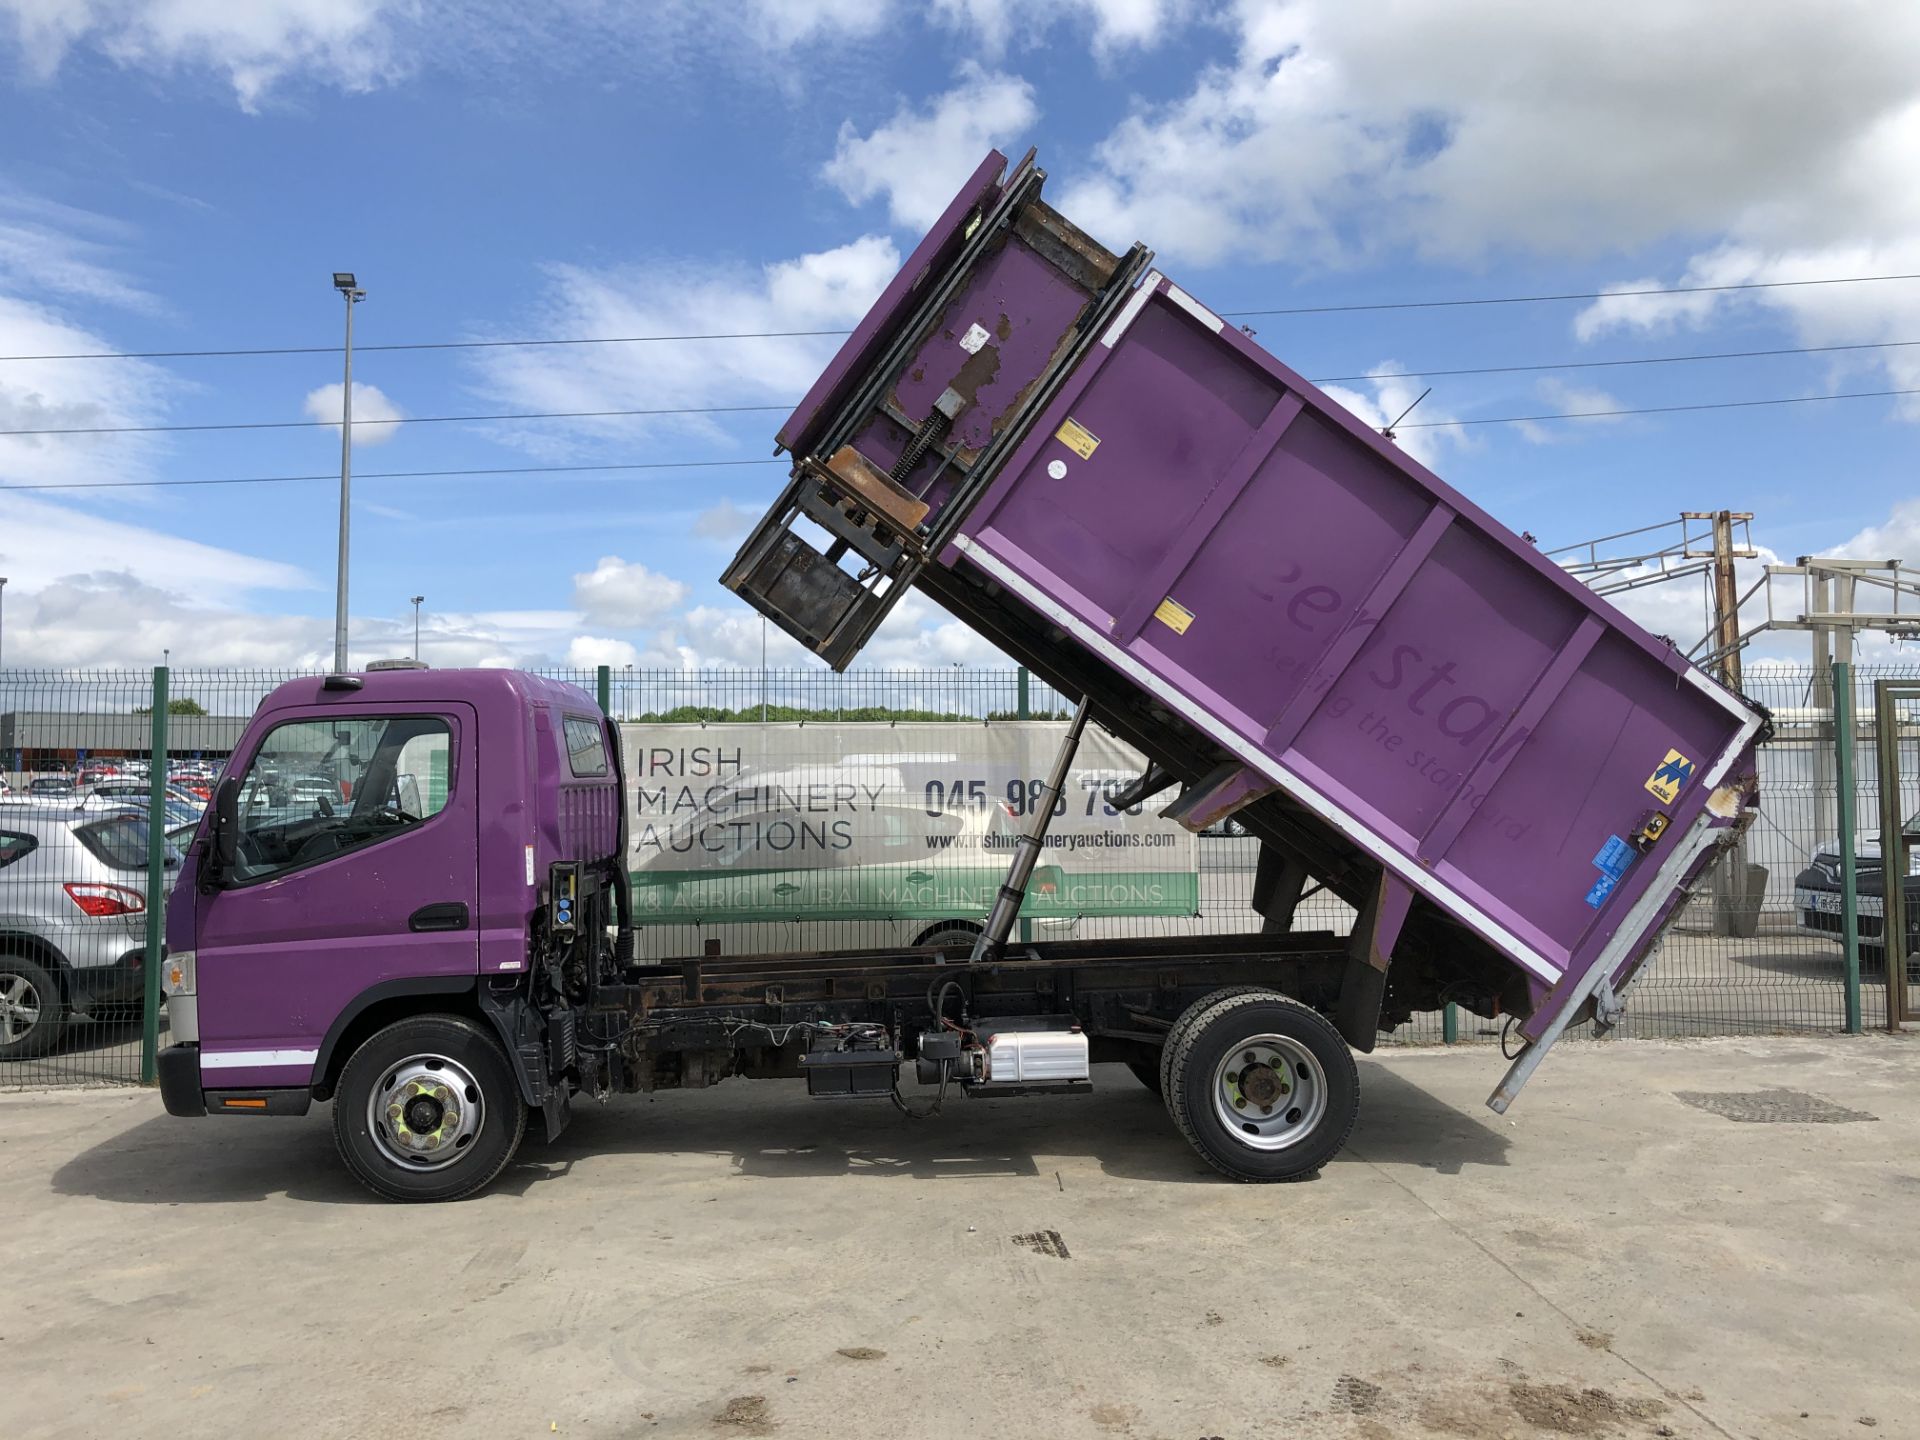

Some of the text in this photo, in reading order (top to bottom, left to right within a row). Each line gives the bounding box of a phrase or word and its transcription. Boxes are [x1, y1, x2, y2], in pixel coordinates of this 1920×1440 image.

[1357, 711, 1403, 752] the
[638, 746, 741, 777] IRISH
[637, 782, 884, 816] MACHINERY
[925, 779, 986, 818] 045
[635, 819, 852, 853] AUCTIONS
[645, 890, 662, 913] &
[1036, 884, 1164, 906] AUCTIONS
